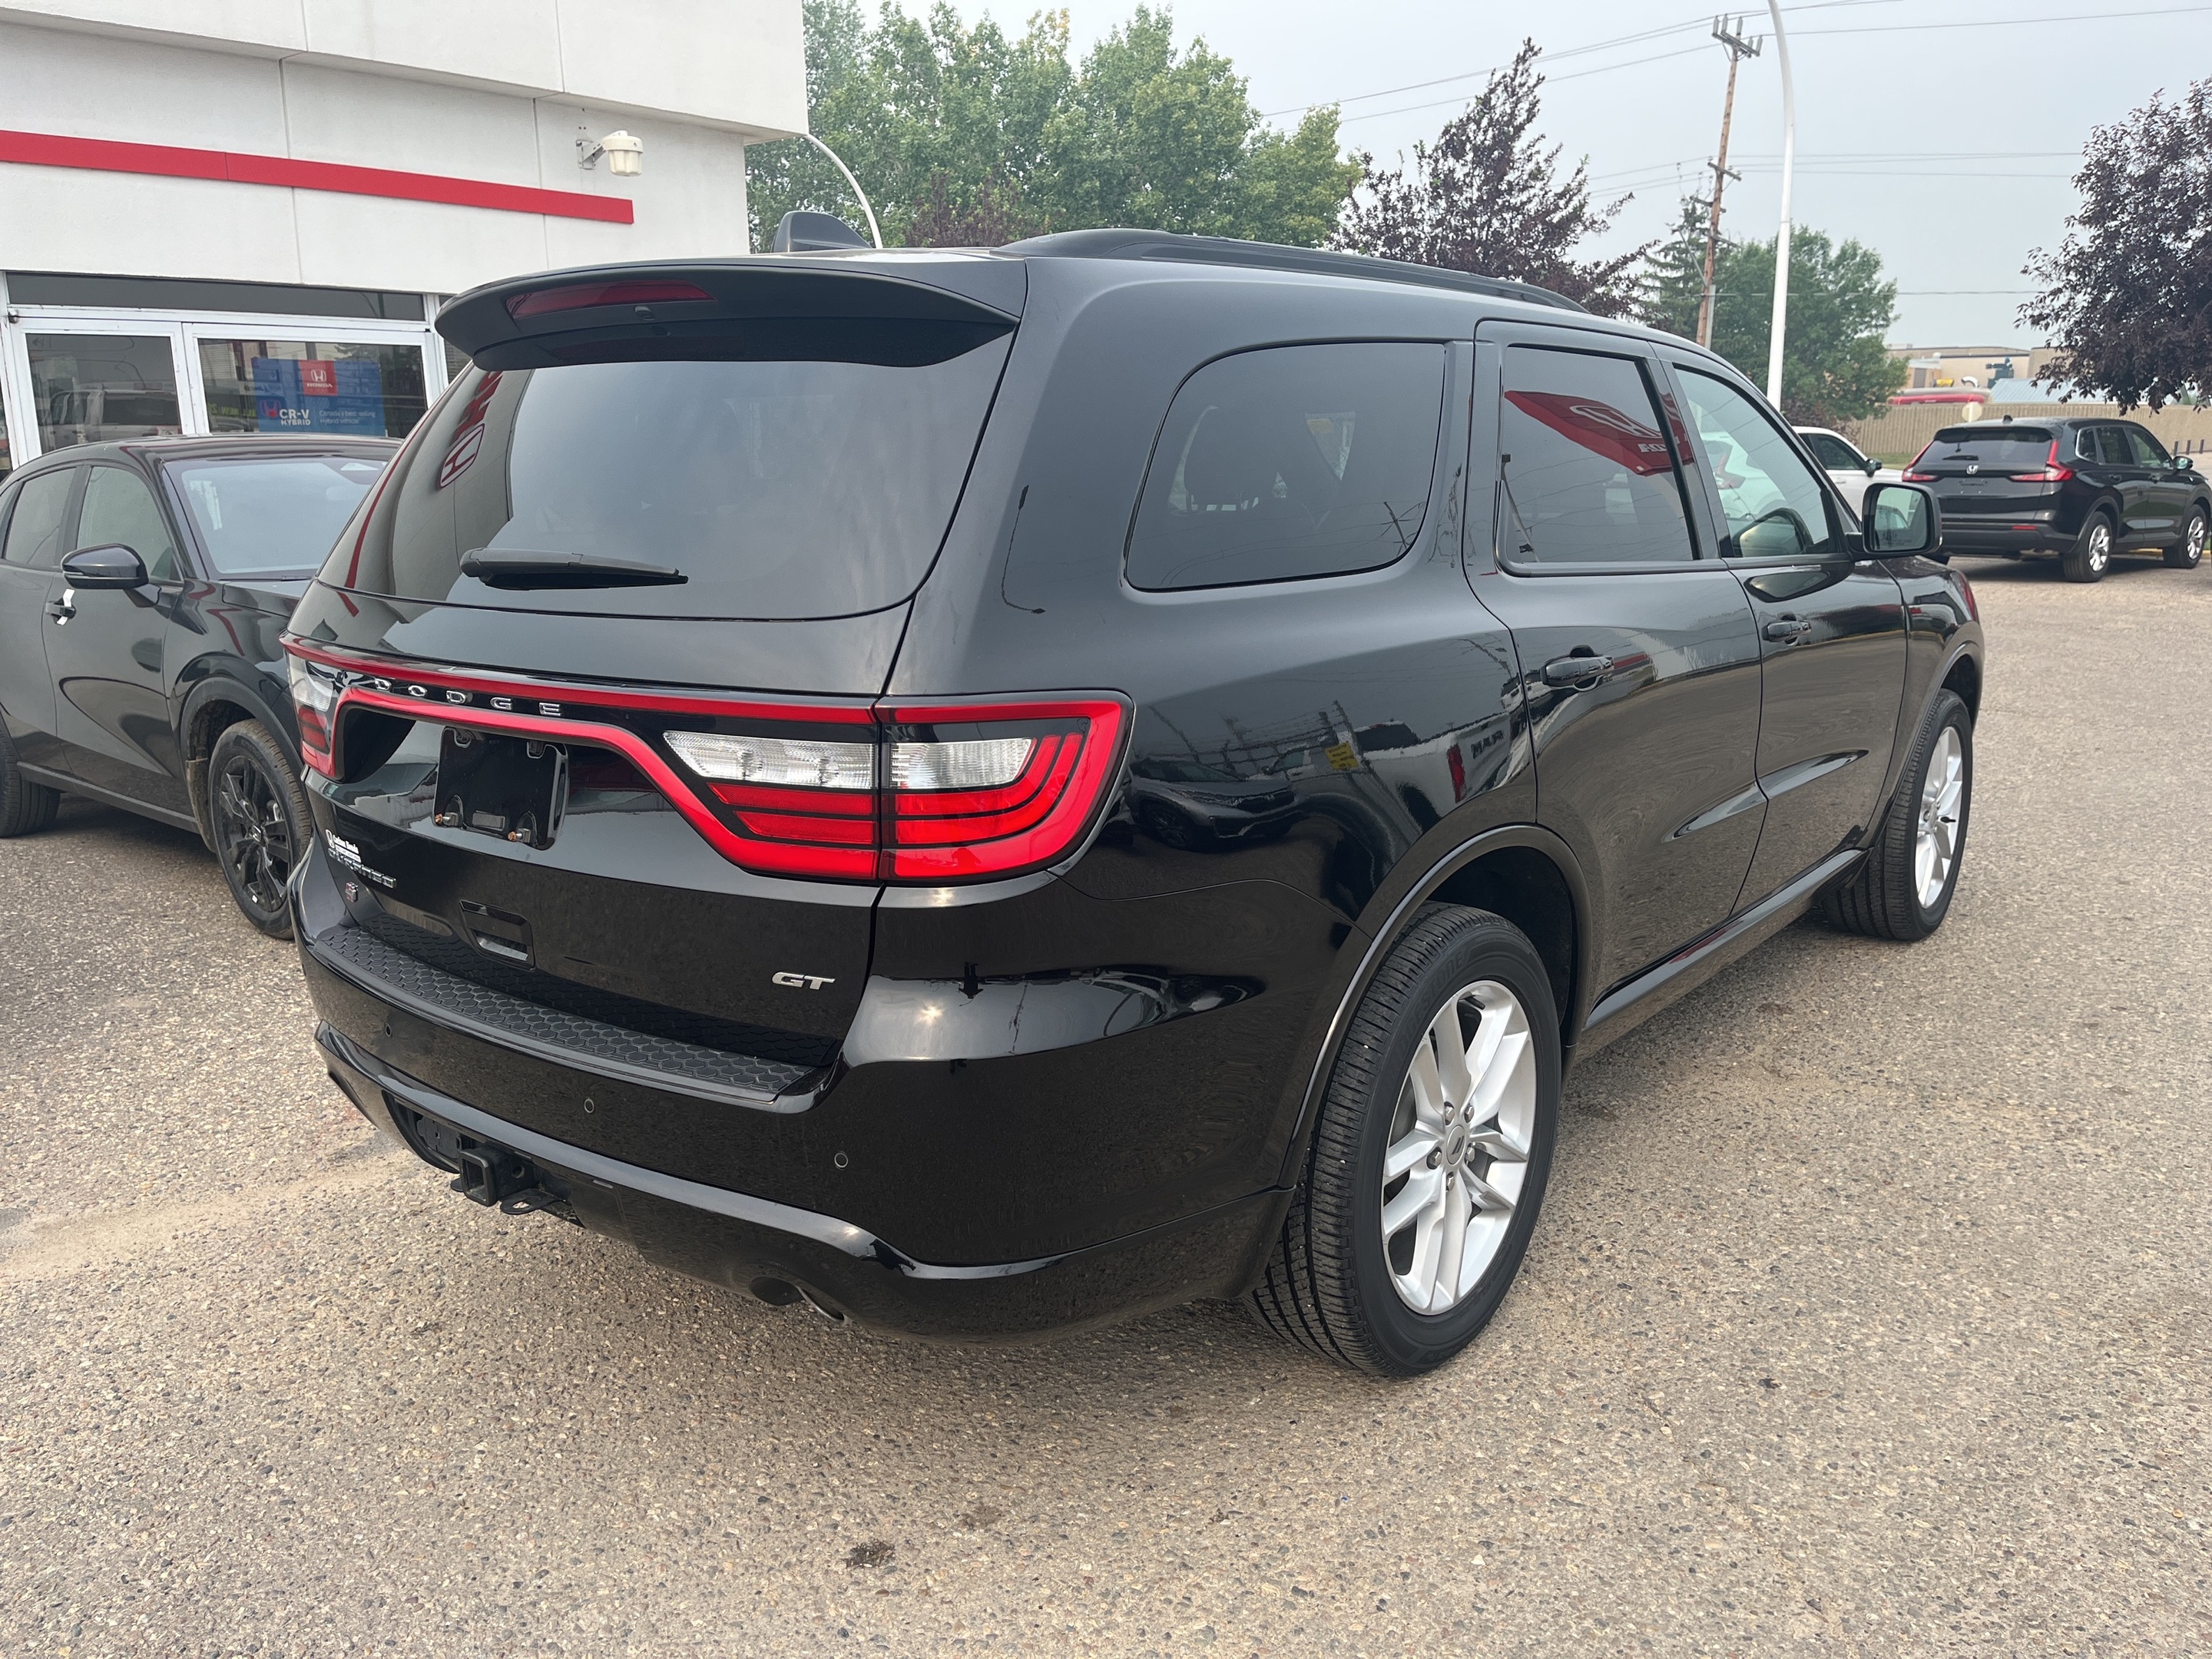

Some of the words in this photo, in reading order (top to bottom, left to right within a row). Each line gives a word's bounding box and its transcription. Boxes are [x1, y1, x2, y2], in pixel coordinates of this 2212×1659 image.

[280, 409, 310, 419] CR-V
[375, 677, 562, 717] DODGE
[772, 972, 836, 990] GT
